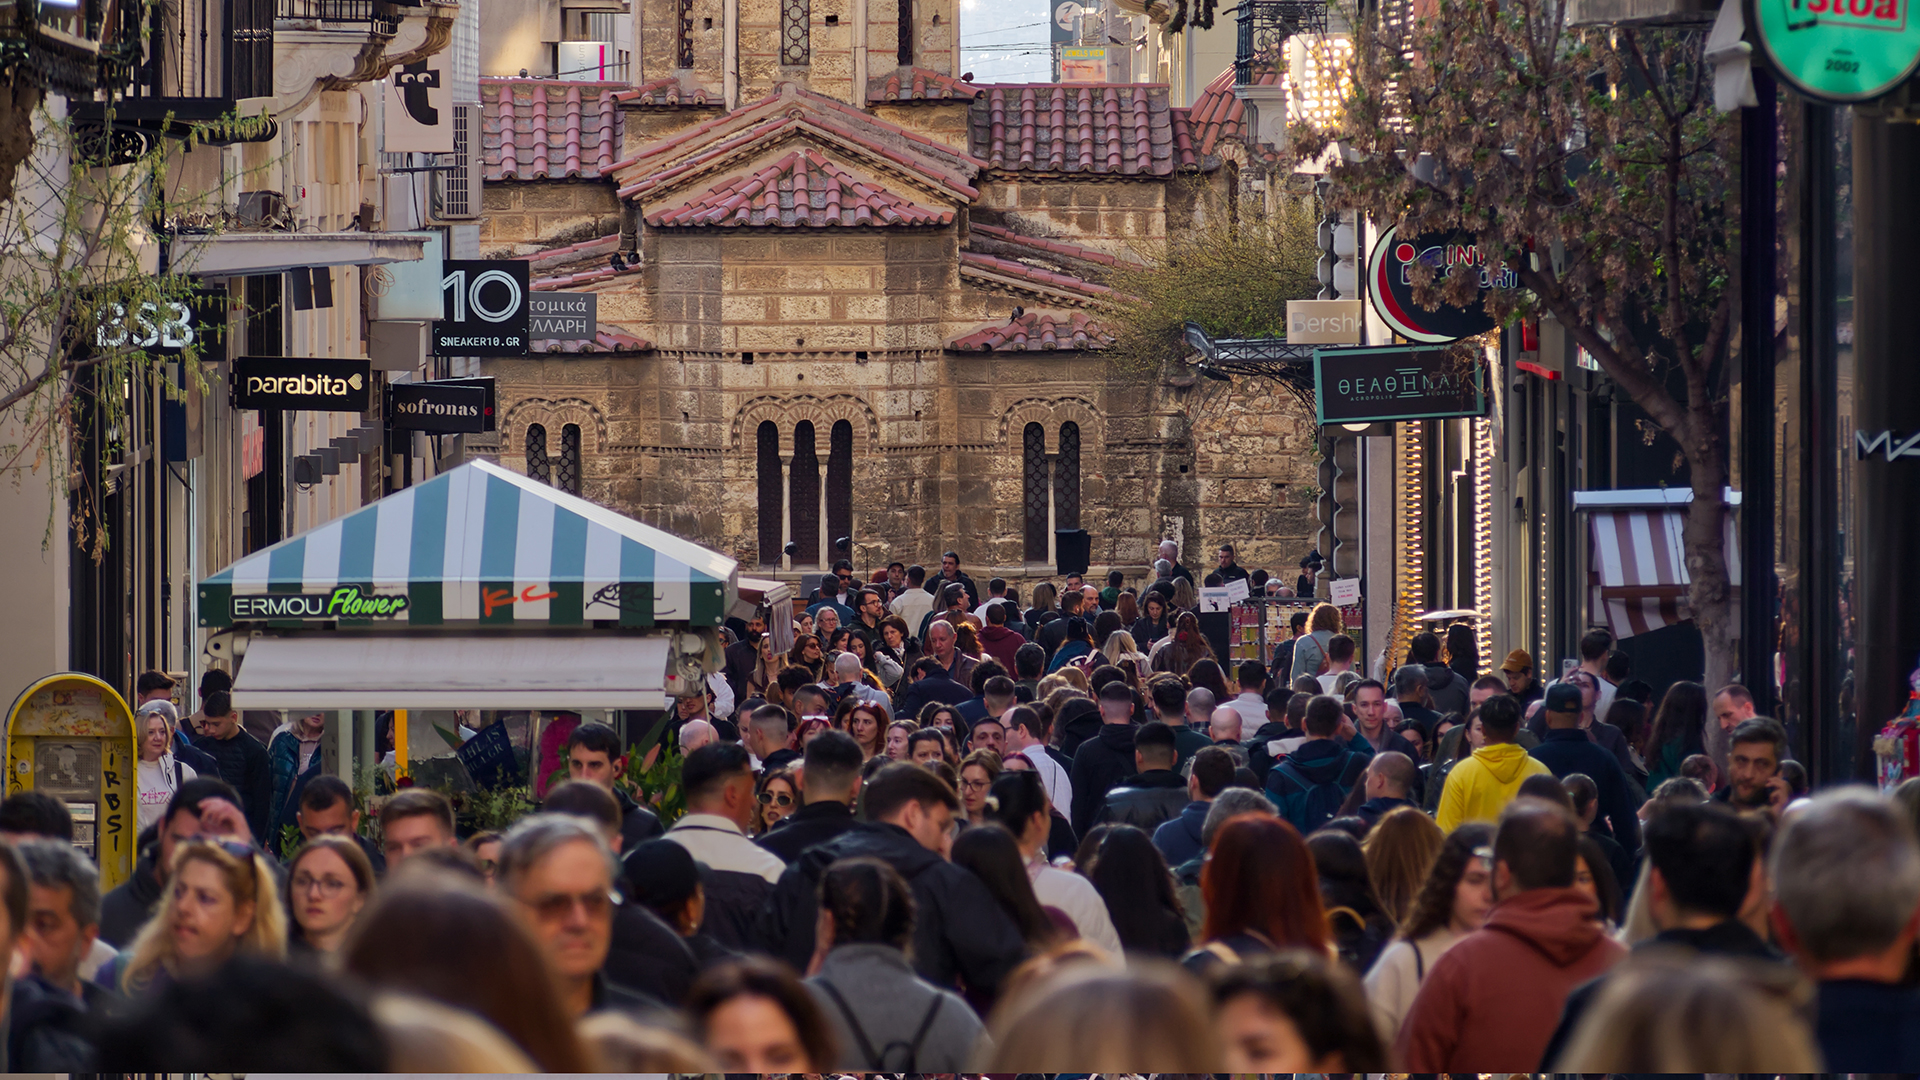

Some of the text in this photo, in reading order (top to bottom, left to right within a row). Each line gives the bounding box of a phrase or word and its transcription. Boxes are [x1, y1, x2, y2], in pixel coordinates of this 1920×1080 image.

[1064, 49, 1105, 57] JEWELS VIEW
[1825, 59, 1860, 73] 2002
[440, 269, 522, 323] 10
[440, 336, 520, 347] SNEAKER10.GR
[247, 373, 348, 396] parabita
[397, 398, 478, 417] sofronas
[234, 588, 406, 616] ERMOU Flower
